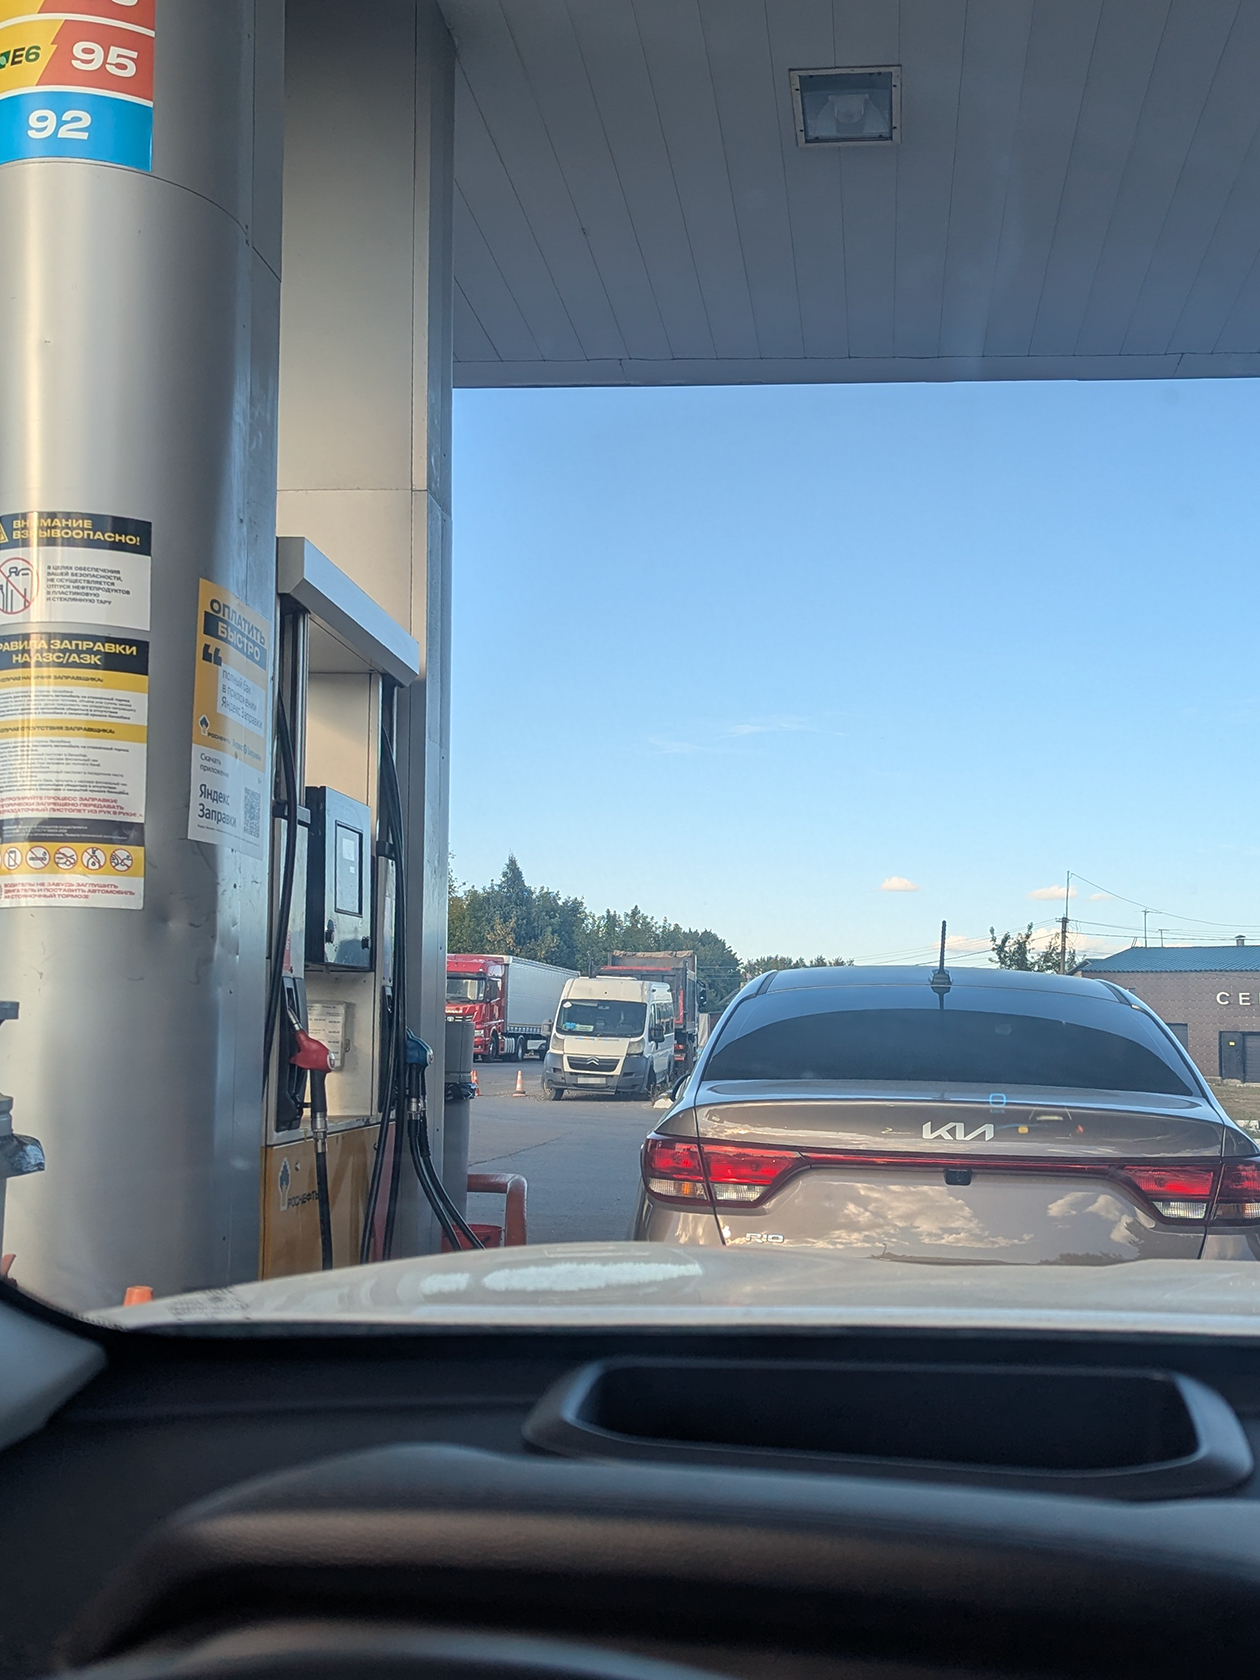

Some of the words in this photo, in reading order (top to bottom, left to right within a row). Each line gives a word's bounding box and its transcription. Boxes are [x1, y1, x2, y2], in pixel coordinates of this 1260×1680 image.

[71, 41, 138, 78] 95
[27, 109, 92, 140] 92
[12, 518, 93, 529] ВНМАНИЕ
[12, 529, 140, 546] ВЗЫВООПАСНО!
[209, 598, 266, 646] ОПЛАТИТЬ
[50, 640, 137, 655] ЗАПРАВКИ
[217, 621, 261, 661] БЫСТРО
[12, 653, 31, 664] НА
[33, 653, 102, 665] АЗС/АЗК
[199, 783, 230, 806] Яндекс
[197, 802, 237, 828] Заправки
[1216, 991, 1260, 1006] СЕ
[922, 1121, 995, 1141] KIA
[746, 1232, 784, 1244] RIO
